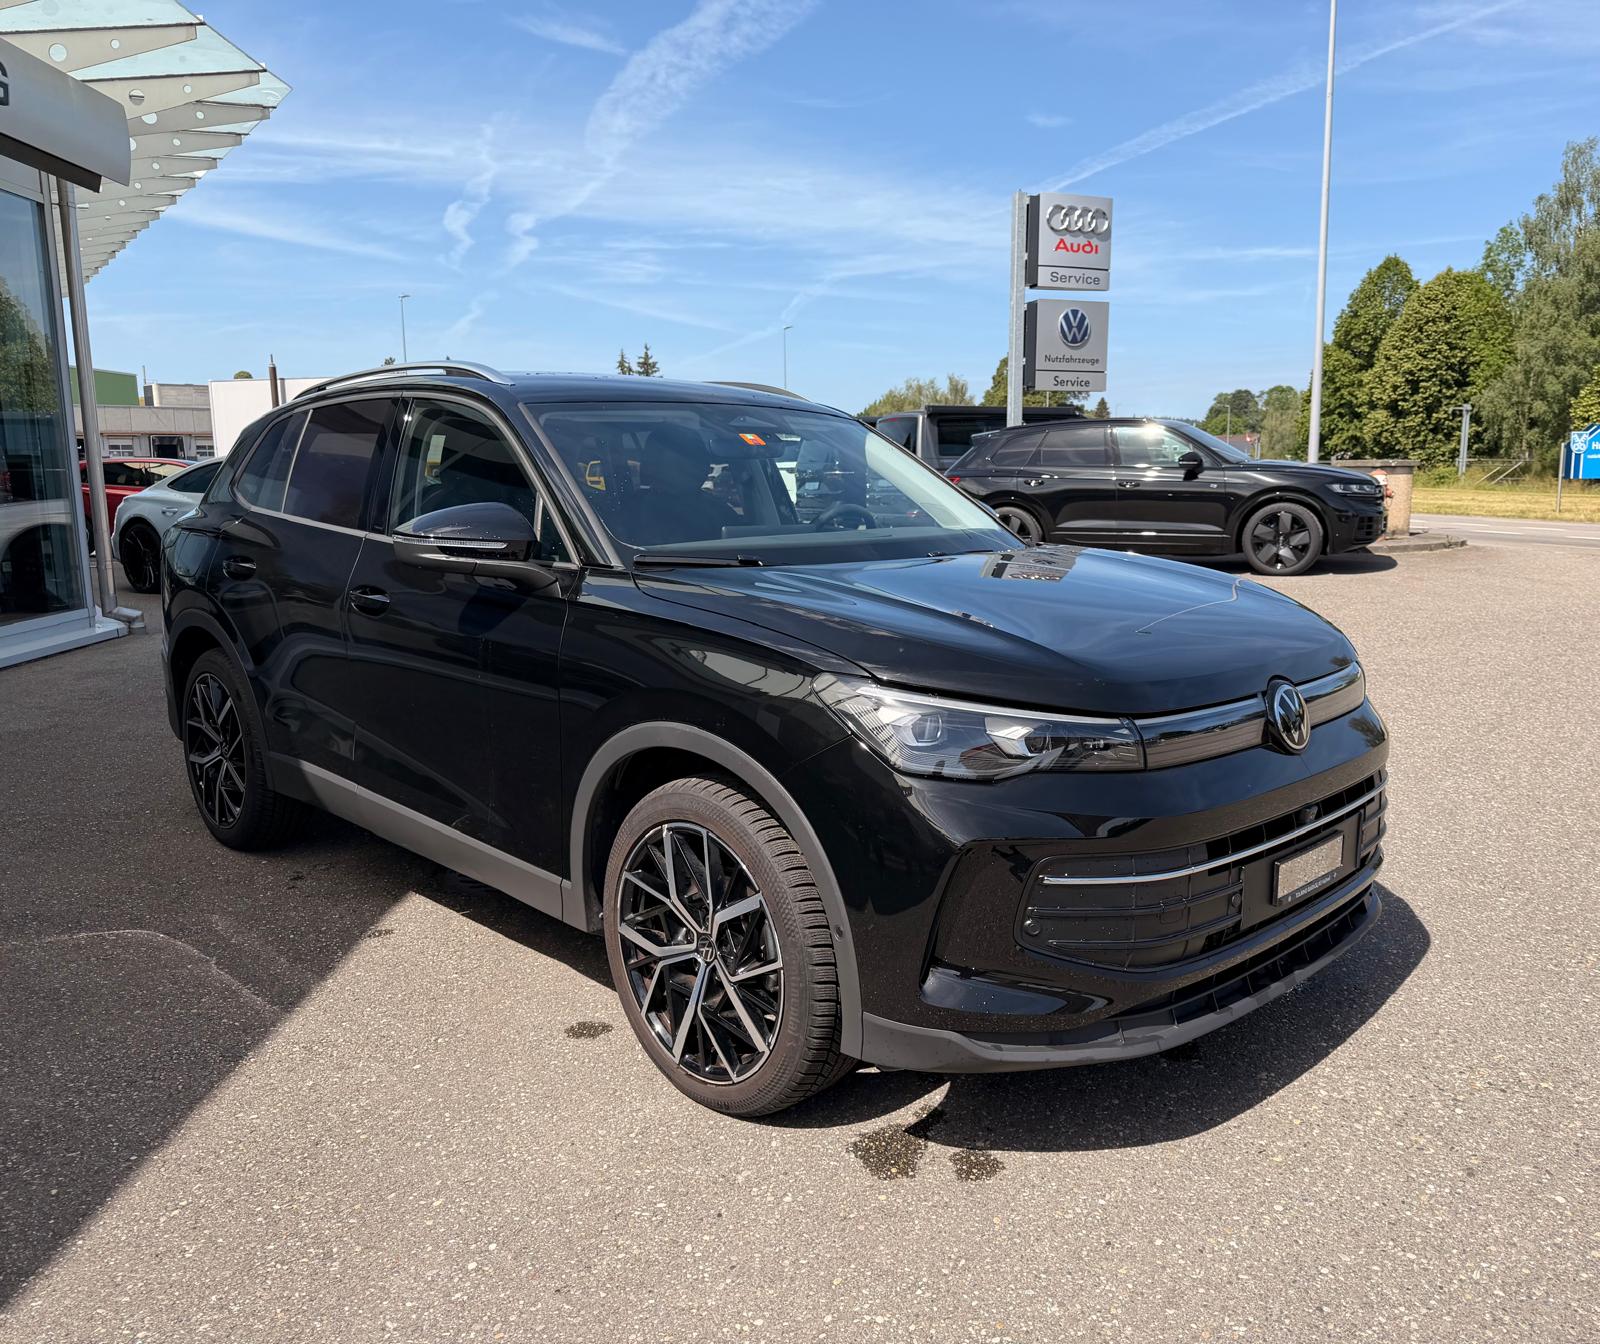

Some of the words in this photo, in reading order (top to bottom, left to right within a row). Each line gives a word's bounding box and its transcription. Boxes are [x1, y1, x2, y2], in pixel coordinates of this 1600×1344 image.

[1054, 238, 1099, 254] Audi
[1050, 271, 1100, 286] Service
[1044, 354, 1100, 366] Nutzfahrzeuge
[1053, 375, 1090, 388] Service
